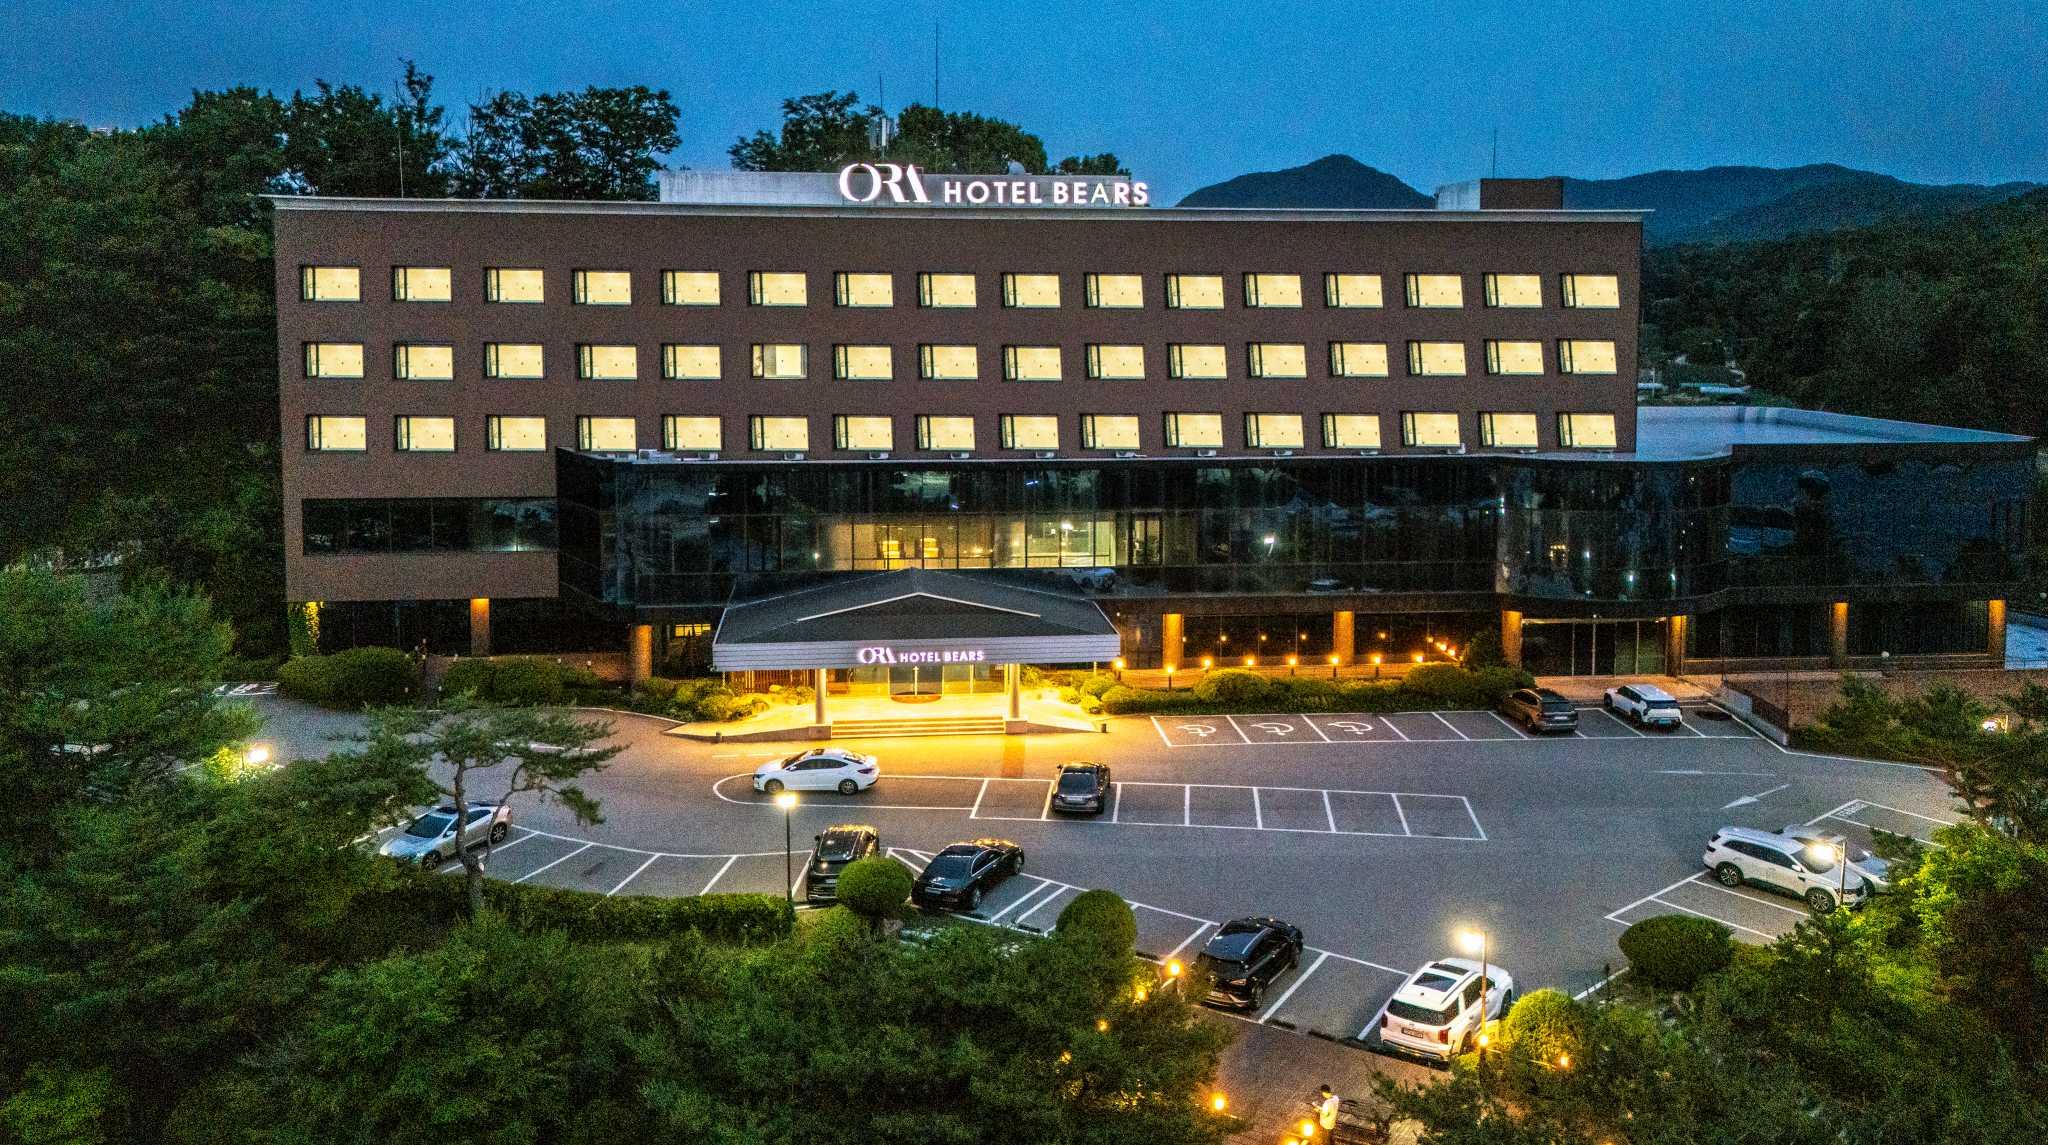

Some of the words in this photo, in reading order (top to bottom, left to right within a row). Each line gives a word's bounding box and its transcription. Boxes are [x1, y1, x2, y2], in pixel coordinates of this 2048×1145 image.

[839, 163, 932, 203] ORA
[944, 181, 1043, 204] HOTEL
[1053, 182, 1148, 205] BEARS
[899, 652, 941, 663] HOTEL
[943, 650, 985, 662] BEARS
